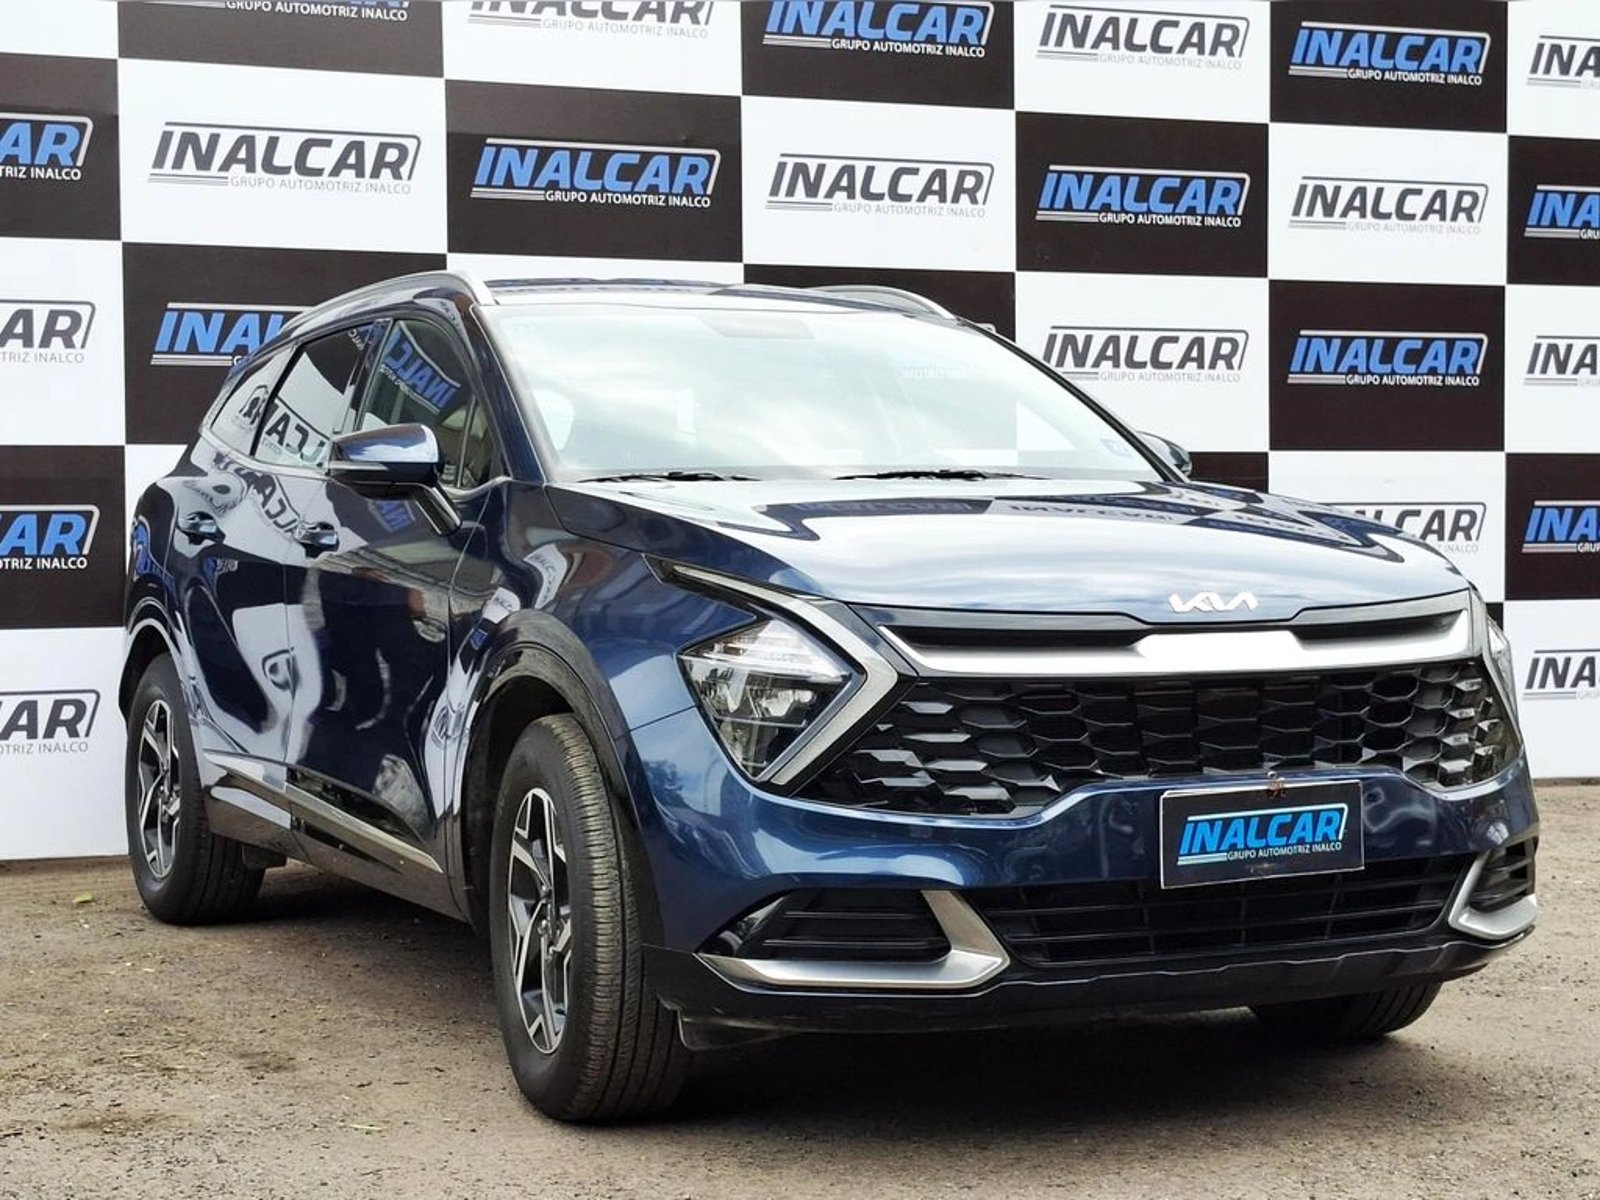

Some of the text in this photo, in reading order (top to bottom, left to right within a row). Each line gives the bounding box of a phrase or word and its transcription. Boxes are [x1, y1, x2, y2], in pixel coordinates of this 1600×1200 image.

[227, 1, 271, 12] GRUPO
[275, 2, 358, 18] AUTOMOTRIZ
[362, 8, 408, 21] INALCO
[542, 19, 709, 39] GRUPO AUTOMOTRIZ INALCO
[765, 1, 984, 45] INALCAR
[1039, 12, 1240, 58] INALCAR
[832, 38, 986, 58] GRUPO AUTOMOTRIZ INALCO
[1291, 29, 1482, 74] INALCAR
[1348, 68, 1482, 86] GRUPO AUTOMOTRIZ INALCO
[151, 130, 410, 181] INALCAR
[31, 166, 82, 180] INALCO
[474, 146, 710, 195] INALCAR
[230, 175, 412, 195] GRUPO AUTOMOTRIZ INALCO
[768, 161, 984, 205] INALCAR
[546, 190, 711, 208] GRUPO AUTOMOTRIZ INALCO
[1038, 173, 1241, 215] INALCAR
[1291, 184, 1480, 223] INALCAR
[833, 202, 986, 219] GRUPO AUTOMOTRIZ INALCO
[1099, 212, 1241, 228] GRUPO AUTOMOTRIZ INALCO
[34, 352, 85, 364] INALCO
[1042, 333, 1240, 370] INALCAR
[1290, 337, 1479, 375] INALCAR
[1346, 374, 1479, 387] GRUPO AUTOMOTRIZ INALCO
[0, 557, 88, 570] TRIZ INALCO
[38, 741, 88, 754] INALCO
[1180, 810, 1341, 855] INALCAR
[1227, 841, 1342, 861] GRUPO AUTOMOTRIZ INALCO
